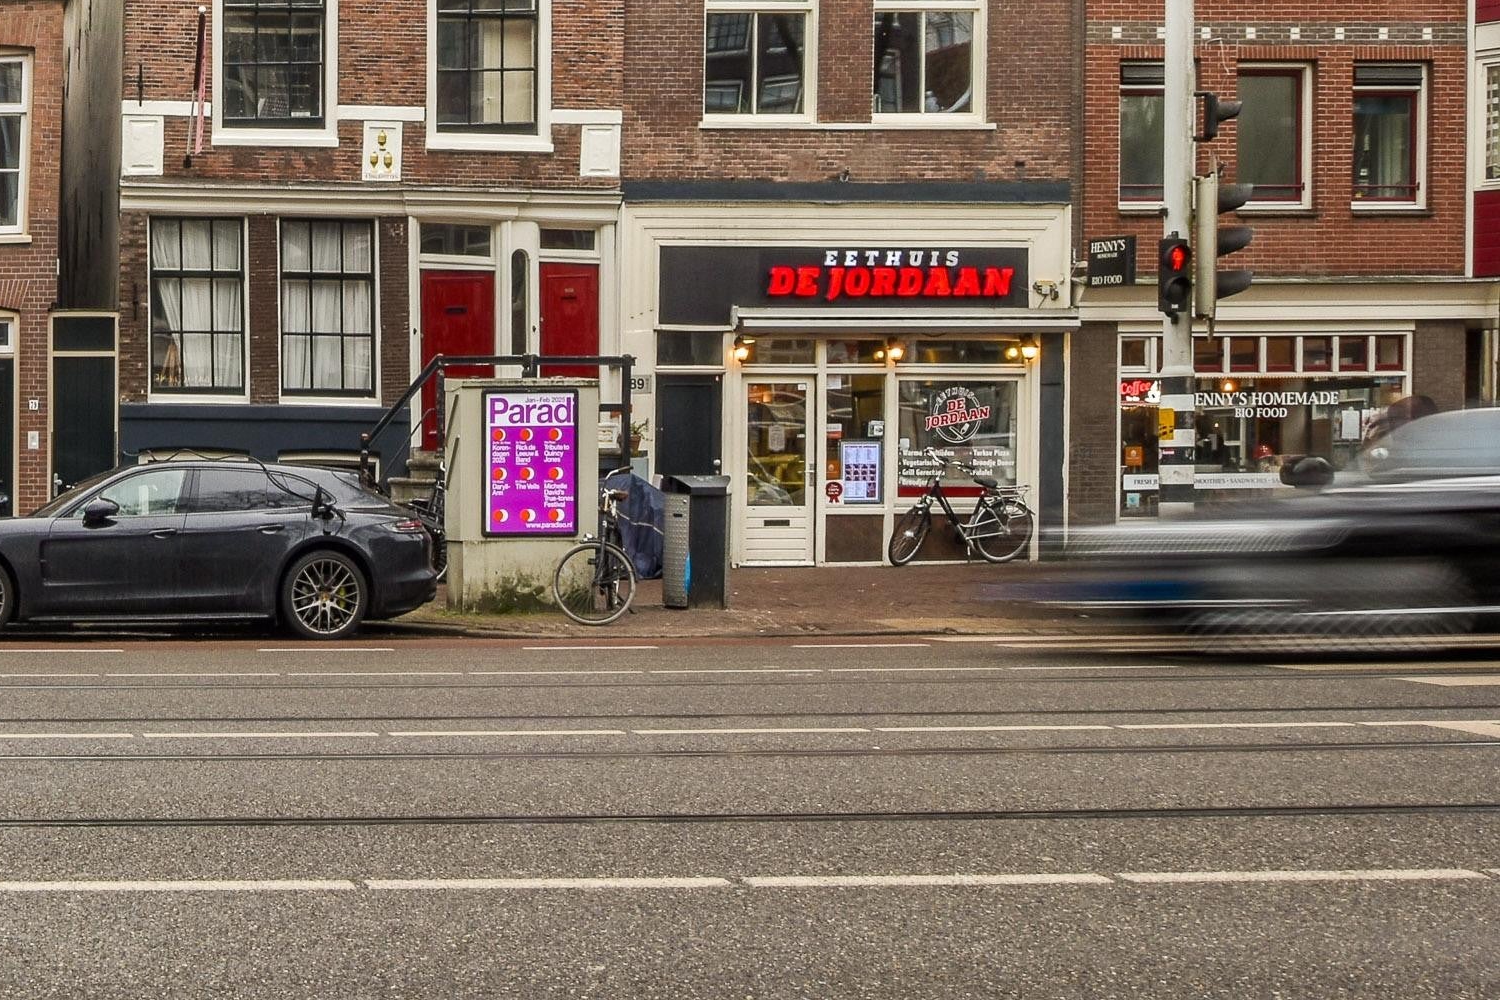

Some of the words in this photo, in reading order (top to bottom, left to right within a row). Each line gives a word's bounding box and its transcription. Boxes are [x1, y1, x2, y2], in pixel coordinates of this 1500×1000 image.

[1091, 240, 1126, 254] HENNY'S
[824, 251, 959, 266] EETHUIS
[768, 267, 821, 296] DE
[825, 267, 1015, 300] JORDAAN
[1092, 277, 1103, 285] BIO
[1104, 275, 1123, 285] FOOD
[1121, 380, 1152, 396] Coffee
[947, 398, 966, 412] DE
[1194, 392, 1247, 406] ENNY'S
[1251, 392, 1339, 406] HOMEMADE
[490, 397, 575, 424] Parad
[1235, 407, 1254, 418] BIO
[1256, 407, 1288, 418] FOOD
[925, 406, 990, 431] JORDAAN
